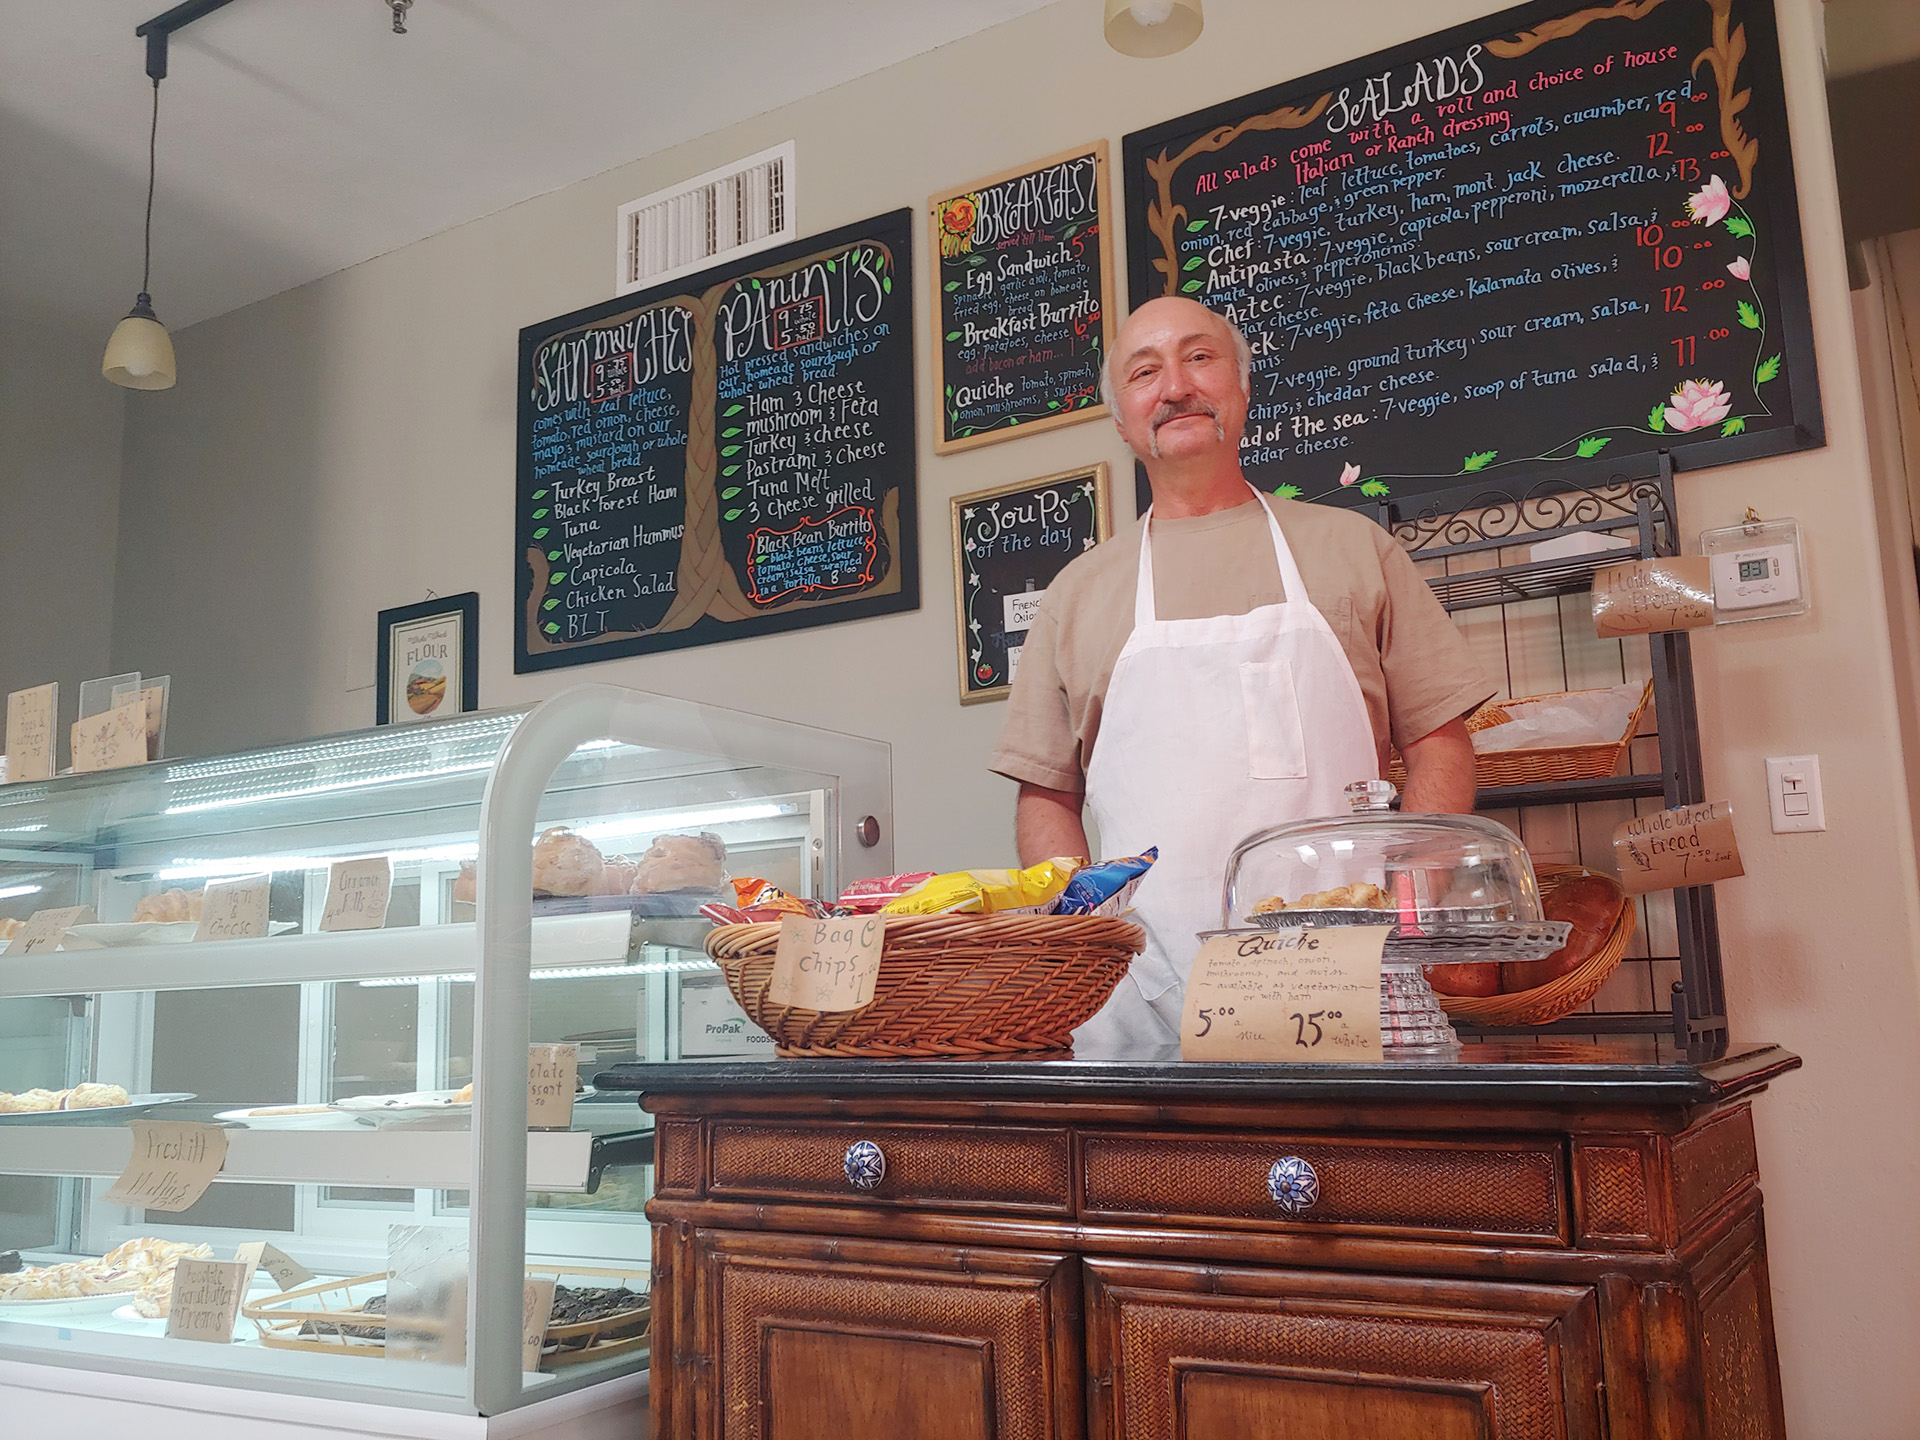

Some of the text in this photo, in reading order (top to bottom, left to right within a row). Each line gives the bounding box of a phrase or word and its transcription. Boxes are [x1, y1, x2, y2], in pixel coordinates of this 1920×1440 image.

[1326, 44, 1484, 133] SALADS
[1195, 45, 1678, 196] All come with a roll and choice of house
[1294, 110, 1513, 185] Italian or Ranch dressing.
[1298, 79, 1692, 205] leaf lettuce, tomatoes, carrots, cucumber, red
[1407, 192, 1451, 213] ham,
[1502, 160, 1546, 192] jack
[1557, 150, 1621, 173] cheese.
[971, 156, 1097, 245] BREAKFAST
[1180, 233, 1225, 251] onion,
[1226, 220, 1252, 242] red
[1262, 200, 1334, 232] cabbage,
[1343, 182, 1389, 211] green
[967, 242, 1073, 297] Egg Sandwich
[1375, 254, 1424, 280] black
[1423, 248, 1481, 269] beans,
[1485, 236, 1524, 254] sour
[1525, 225, 1583, 246] cream,
[1034, 287, 1046, 297] on
[1363, 301, 1402, 324] feta
[1407, 287, 1464, 310] cheese,
[963, 290, 1099, 347] Breakfast Burrito
[1034, 328, 1070, 345] cheese
[720, 323, 891, 378] Hot pressed sandwiches on
[1347, 346, 1400, 380] ground
[1479, 324, 1517, 343] sour
[1524, 311, 1585, 332] cream,
[718, 374, 740, 390] our
[800, 345, 859, 370] sourdough
[862, 340, 881, 353] or
[718, 382, 753, 399] whole
[758, 373, 795, 390] wheat
[746, 380, 866, 417] Ham Cheese
[955, 375, 1015, 408] Quiche
[1307, 383, 1373, 407] cheddar
[1379, 369, 1440, 392] cheese.
[533, 413, 563, 433] comes
[746, 397, 879, 437] mushroom Feta
[1265, 422, 1282, 443] of
[1290, 414, 1327, 439] the
[1464, 379, 1504, 400] scoop
[1509, 371, 1528, 390] of
[1531, 368, 1578, 386] tuna
[571, 418, 592, 439] red
[575, 418, 673, 451] mustard on our
[744, 433, 797, 458] Turkey
[1295, 435, 1354, 455] cheese.
[586, 430, 688, 466] sourdough or whole
[745, 441, 887, 480] Pastrami Cheese
[551, 465, 656, 503] Turkey Breast
[554, 483, 678, 520] Black Forest Ham
[746, 468, 831, 500] Tuna Melt
[748, 501, 760, 524] 3
[825, 478, 876, 514] grilled
[561, 520, 600, 539] Tuna
[563, 524, 685, 568] Vegetarian Hummus
[756, 514, 872, 555] Black Bean Burrito
[976, 525, 1074, 559] of the day
[566, 571, 677, 610] Chicken Salad
[570, 557, 637, 587] Capicola
[407, 644, 448, 666] FLOUR
[1627, 814, 1673, 837] Whole
[813, 922, 854, 954] Bag
[1237, 932, 1320, 958] Quiche
[705, 1024, 741, 1034] ProPak
